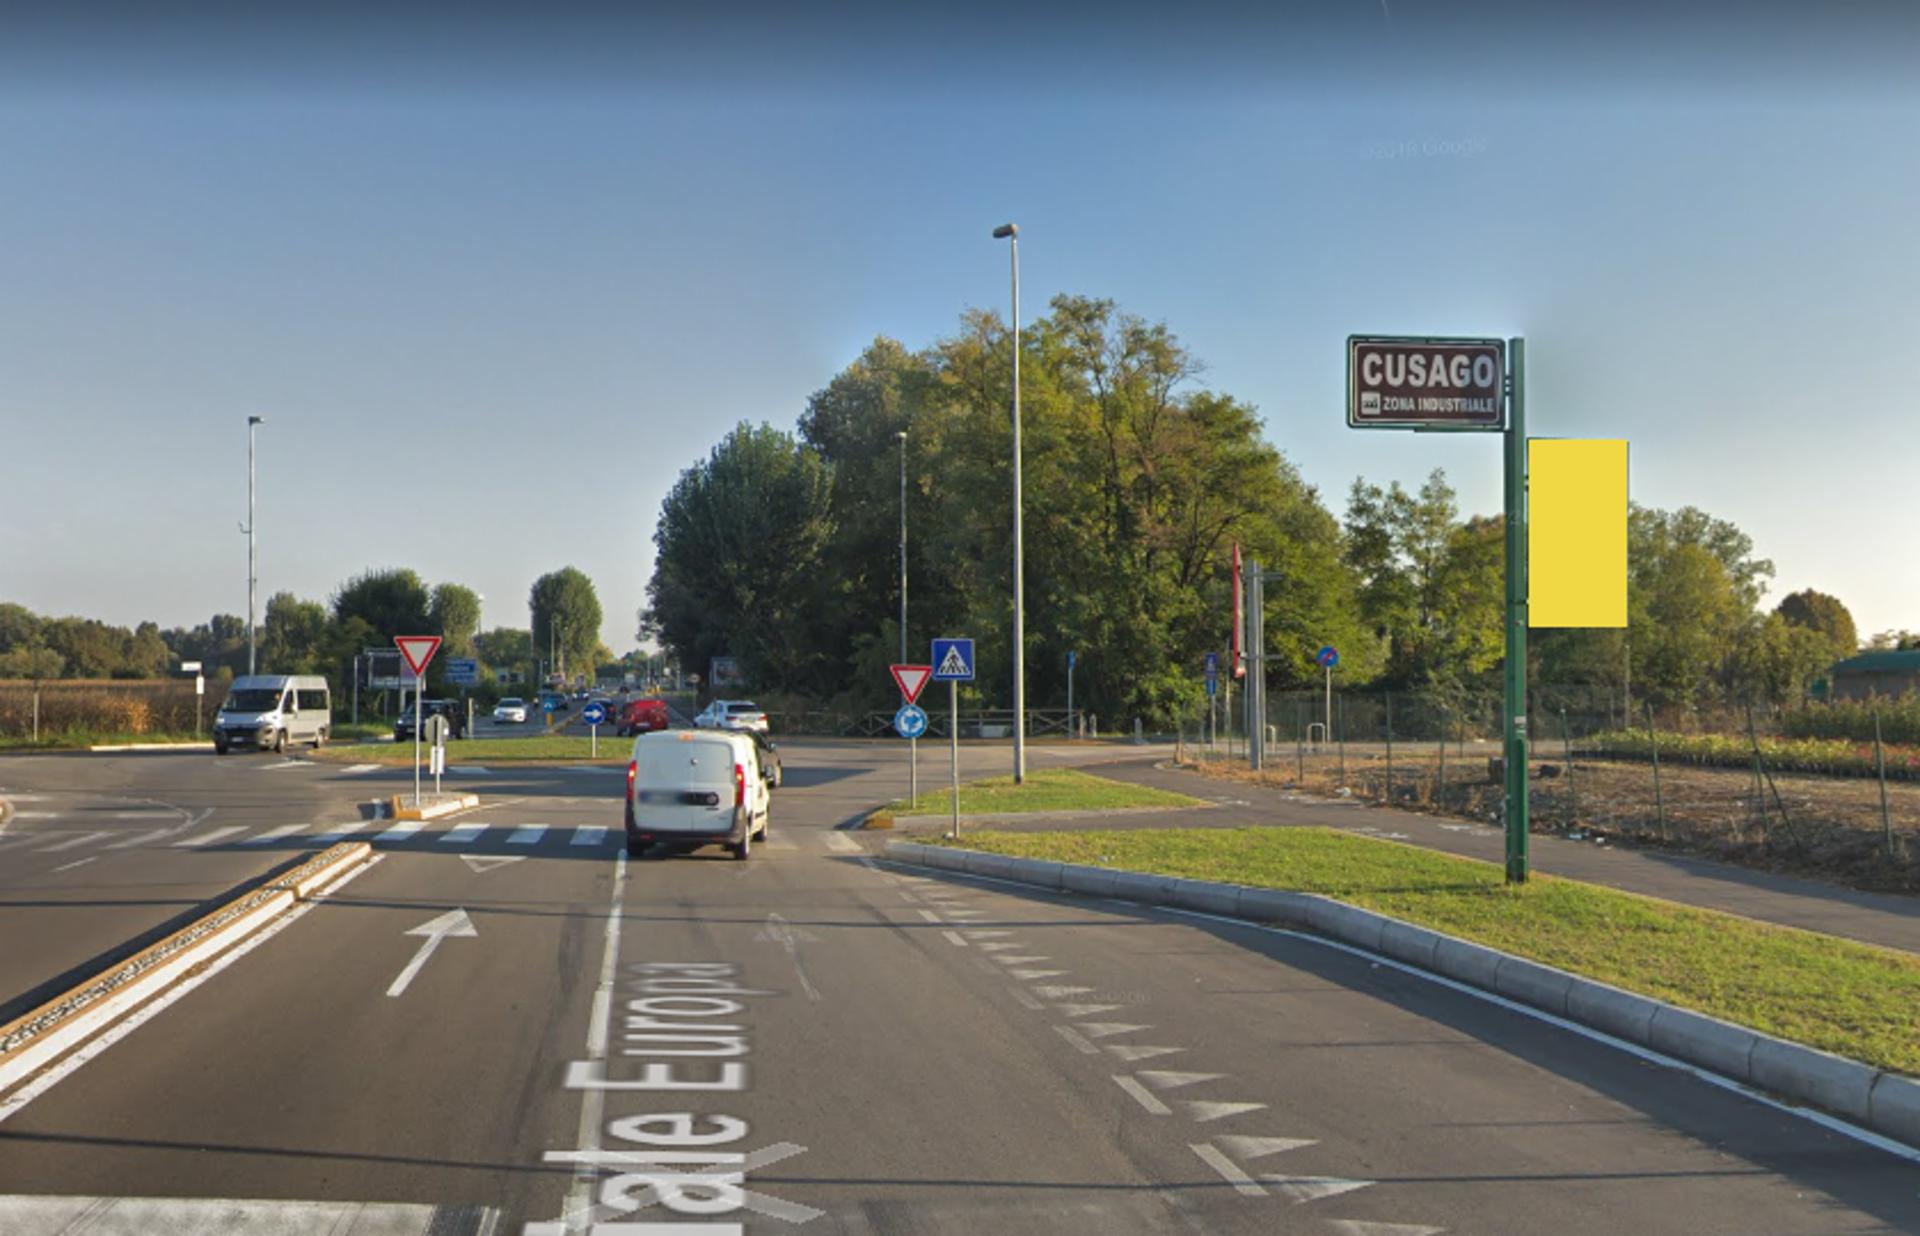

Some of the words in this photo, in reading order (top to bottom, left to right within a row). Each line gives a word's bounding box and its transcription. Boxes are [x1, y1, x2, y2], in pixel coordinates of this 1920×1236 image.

[1363, 352, 1494, 387] CUSAGO
[1383, 397, 1415, 411] ZONA
[1418, 397, 1494, 413] INDUSTRIALE
